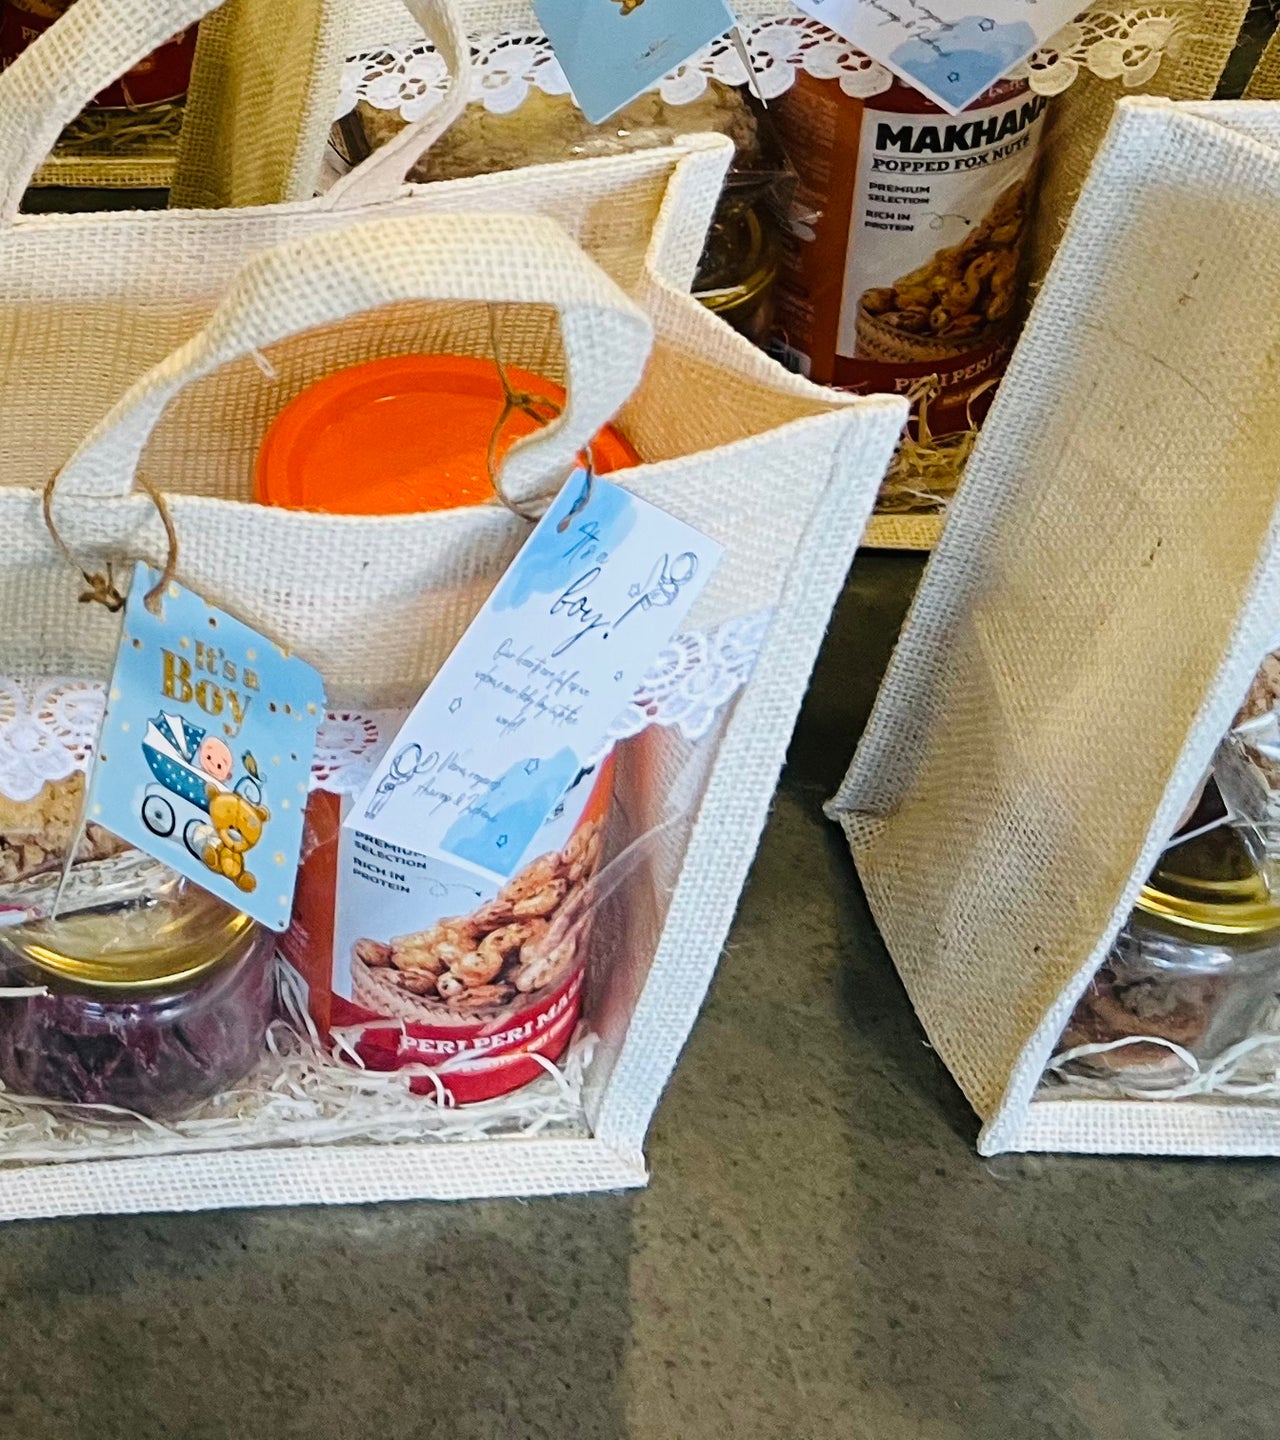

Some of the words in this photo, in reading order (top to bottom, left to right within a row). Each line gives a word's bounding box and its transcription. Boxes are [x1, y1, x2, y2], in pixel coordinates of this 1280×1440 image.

[872, 157, 950, 174] POPPED
[954, 154, 989, 171] FOX
[868, 193, 930, 205] SELECTION
[869, 182, 930, 194] PREMIUM
[865, 221, 914, 233] PROTEIN
[866, 210, 894, 221] RICH
[897, 212, 910, 222] IN
[551, 568, 644, 657] boy!
[160, 647, 252, 738] Boy
[354, 840, 427, 870] SELECTION
[353, 857, 386, 876] RICH
[390, 871, 405, 882] IN
[353, 868, 410, 894] PROTEIN
[401, 1034, 468, 1055] PERI
[471, 1021, 534, 1050] PERI
